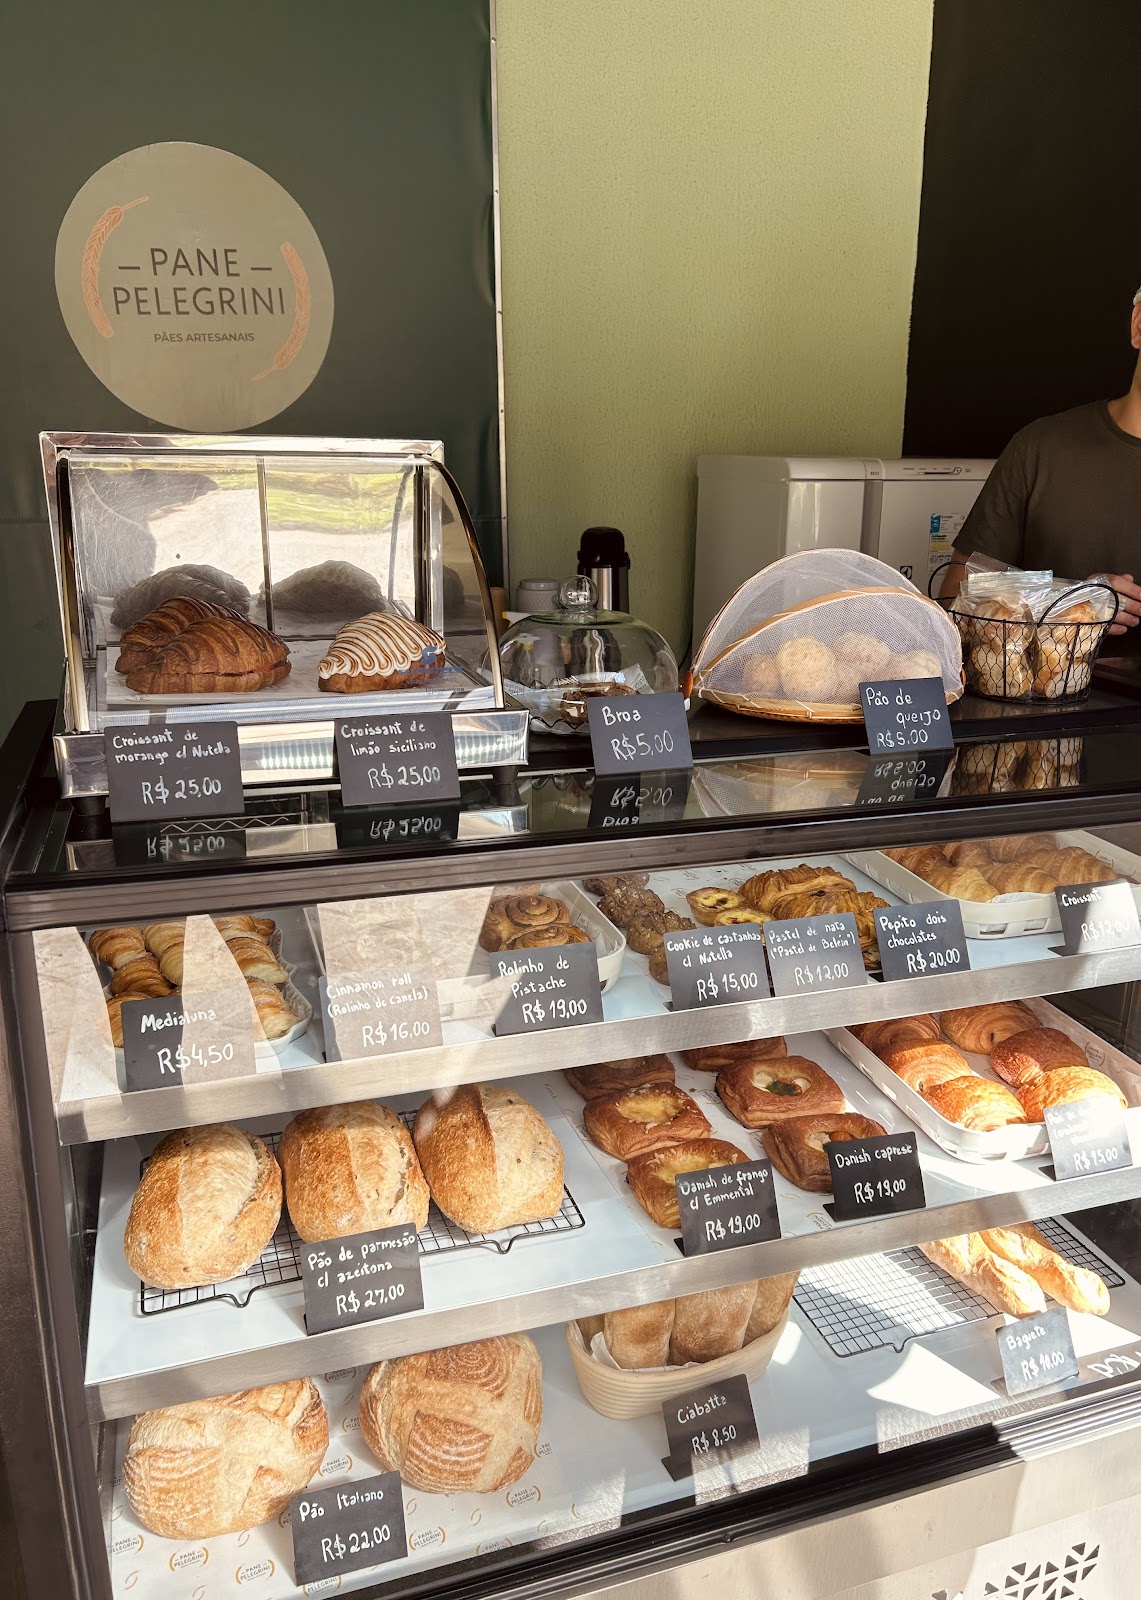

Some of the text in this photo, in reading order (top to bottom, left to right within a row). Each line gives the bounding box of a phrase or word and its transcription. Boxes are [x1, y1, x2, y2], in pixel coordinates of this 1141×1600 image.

[150, 248, 240, 277] PANE
[113, 287, 286, 315] PELEGRINI
[154, 332, 255, 343] PÃES ARTESANAIS
[865, 687, 913, 706] Pão de
[601, 705, 642, 726] Broa
[896, 709, 941, 729] queijo
[112, 729, 199, 749] Croissant de
[341, 721, 426, 739] Croissant de
[115, 751, 169, 765] morango
[192, 741, 231, 758] Nutella
[350, 738, 436, 756] limão siciliano
[1061, 888, 1102, 907] Croissant
[768, 922, 846, 944] Pastel de nata
[879, 911, 947, 934] Pepito dois
[666, 931, 761, 952] Cookie de castanhas
[808, 944, 817, 952] de
[887, 930, 937, 949] chocolates
[498, 955, 570, 978] Rolinho de
[699, 946, 733, 965] Nutella
[326, 972, 412, 999] Cinnamon roll
[511, 976, 567, 998] Pistache
[375, 997, 387, 1009] de
[389, 985, 428, 1005] canela)
[140, 1009, 217, 1034] Medialuna
[835, 1144, 913, 1169] Danish caprese
[679, 1169, 769, 1196] Danish de frango
[703, 1182, 754, 1206] Emmental
[307, 1232, 416, 1271] Pão de parmesão
[337, 1261, 393, 1283] azeitona
[1006, 1325, 1046, 1351] Baguete
[677, 1394, 727, 1424] Ciabatta
[299, 1501, 325, 1522] Pão
[337, 1490, 384, 1510] Italiano
[173, 1552, 205, 1568] PELEGRINI
[179, 1551, 196, 1560] PANE
[240, 1565, 270, 1581] PELEGRINI
[245, 1563, 261, 1572] PANE
